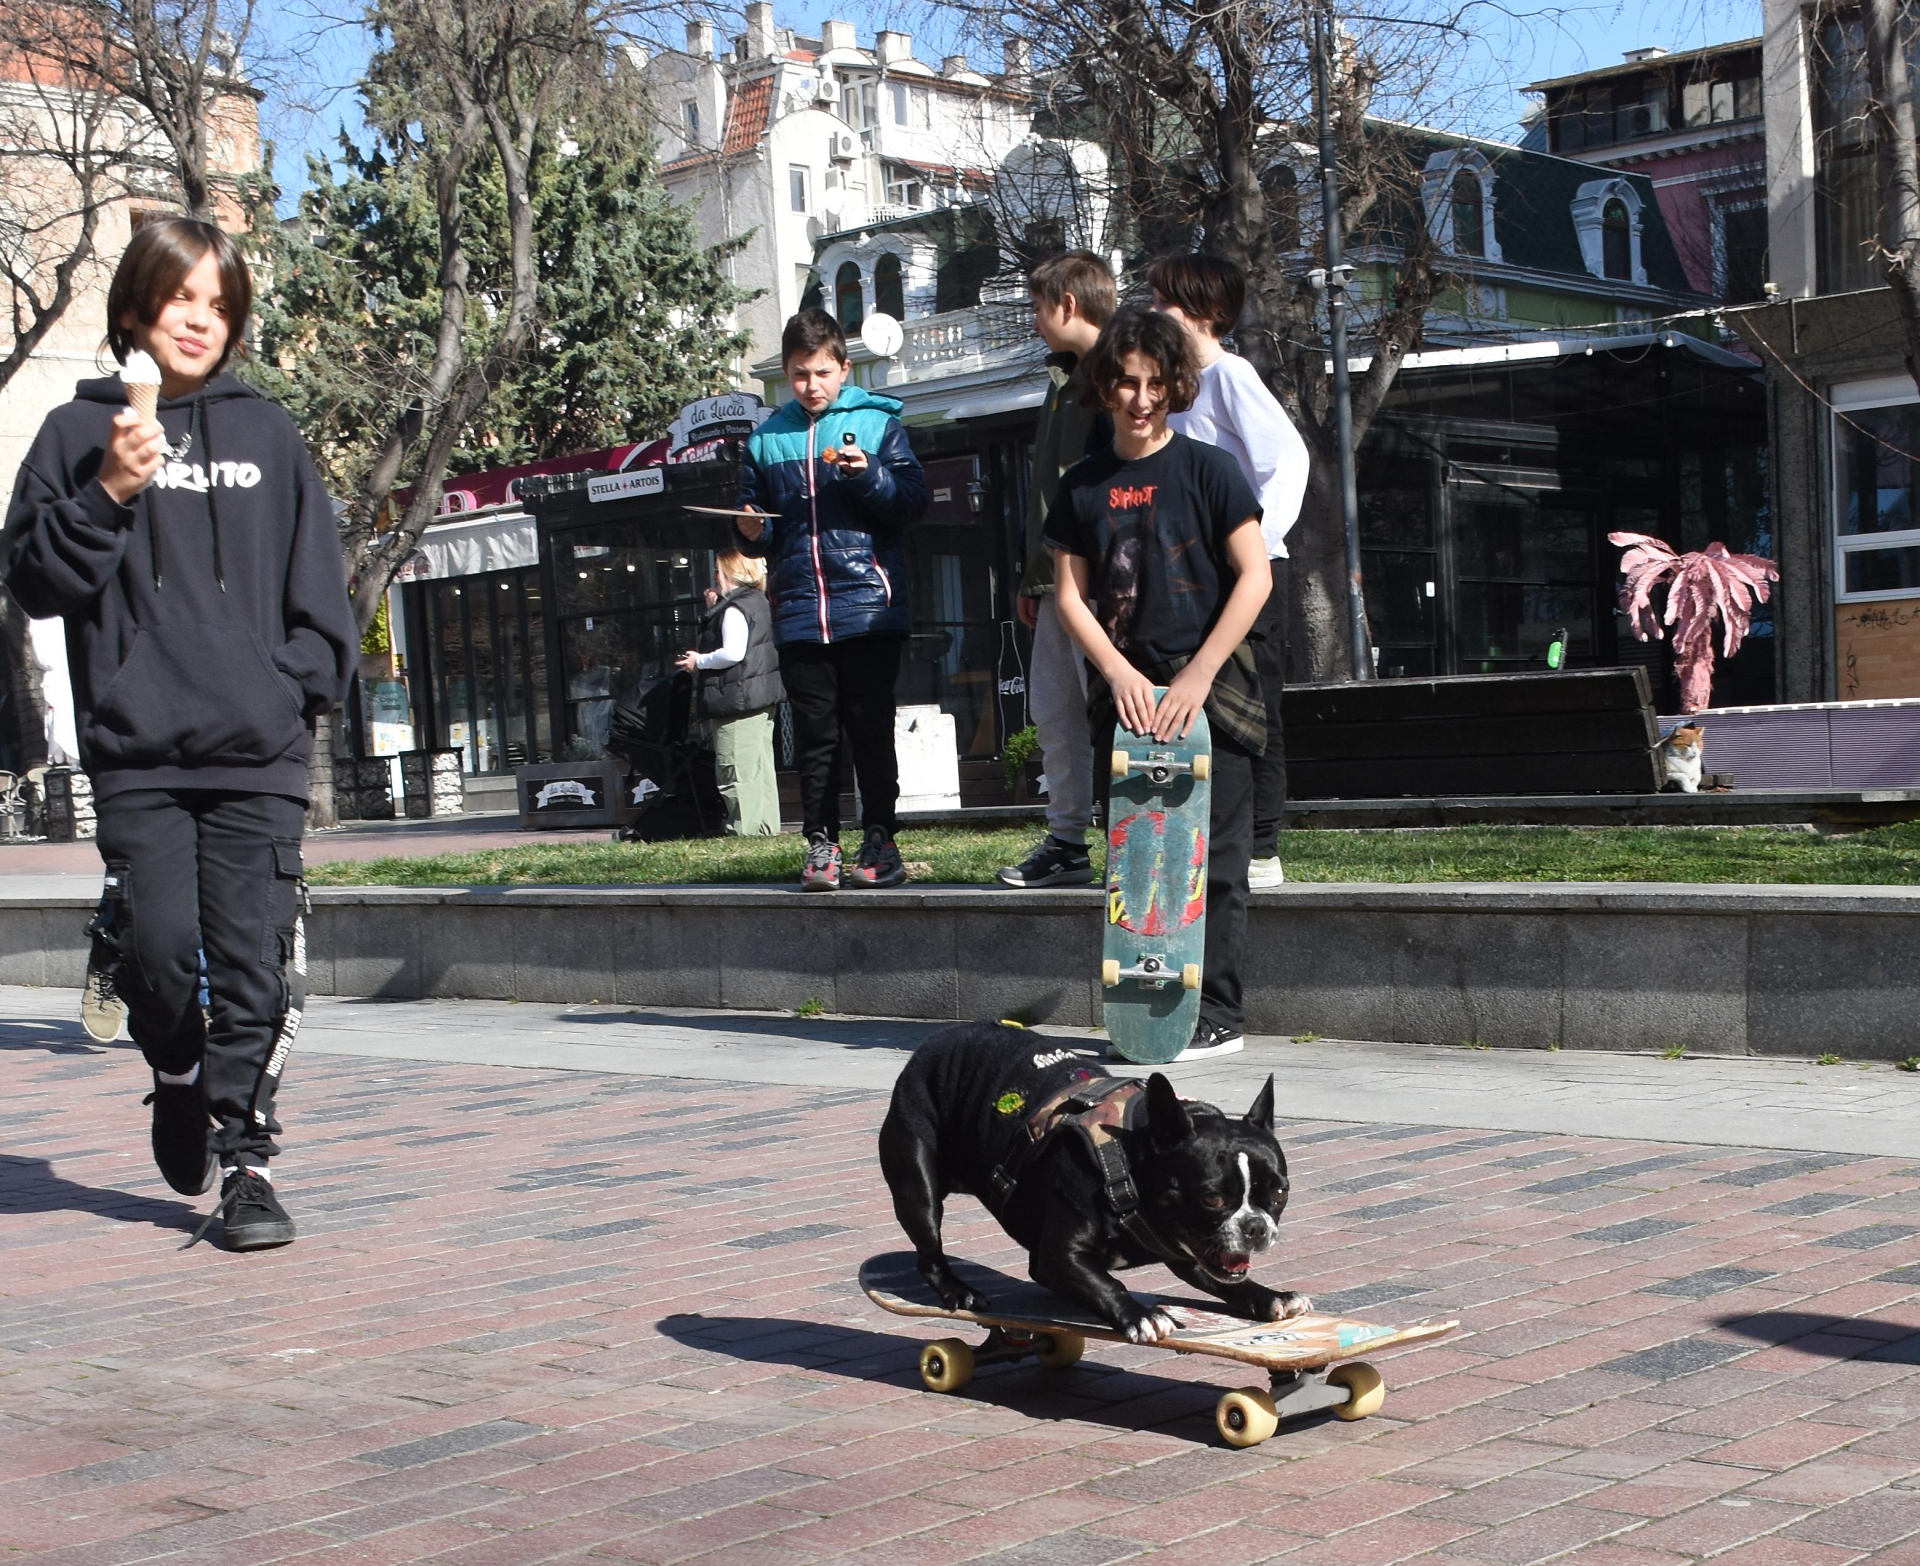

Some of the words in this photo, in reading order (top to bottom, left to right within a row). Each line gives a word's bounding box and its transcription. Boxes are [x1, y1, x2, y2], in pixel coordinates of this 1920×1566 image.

[691, 405, 706, 425] da
[710, 400, 747, 420] Lucio
[152, 461, 262, 493] ARLITO
[591, 482, 621, 495] STELLA
[629, 476, 660, 490] ARTOIS
[294, 932, 307, 976] FASHION
[283, 1006, 303, 1037] BEST
[265, 1033, 294, 1078] FASHION
